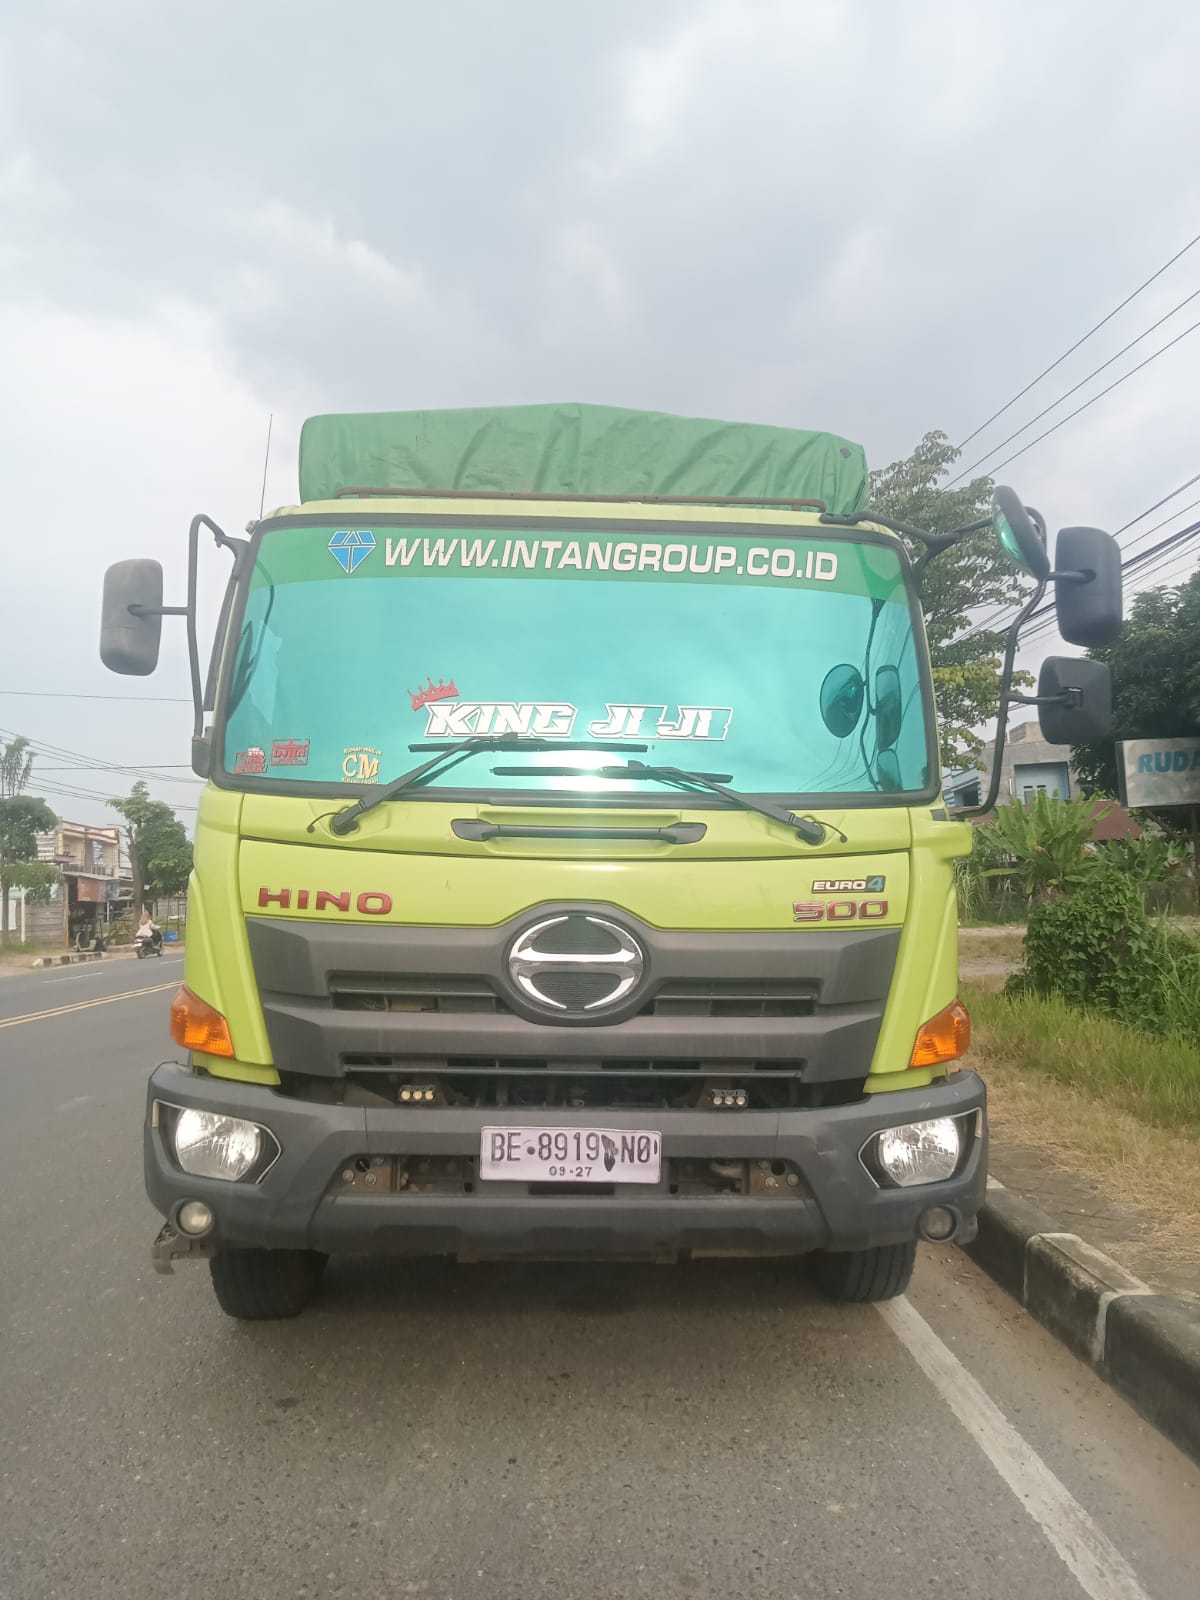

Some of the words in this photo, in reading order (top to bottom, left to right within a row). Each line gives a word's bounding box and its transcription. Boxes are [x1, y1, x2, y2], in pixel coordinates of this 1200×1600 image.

[384, 538, 838, 581] WWW.INTANGROUP.CO.ID
[424, 702, 578, 737] KING
[342, 754, 379, 779] CM
[258, 887, 392, 915] HINO
[793, 900, 888, 921] 500
[491, 1132, 521, 1162] BE
[537, 1132, 600, 1162] 8919
